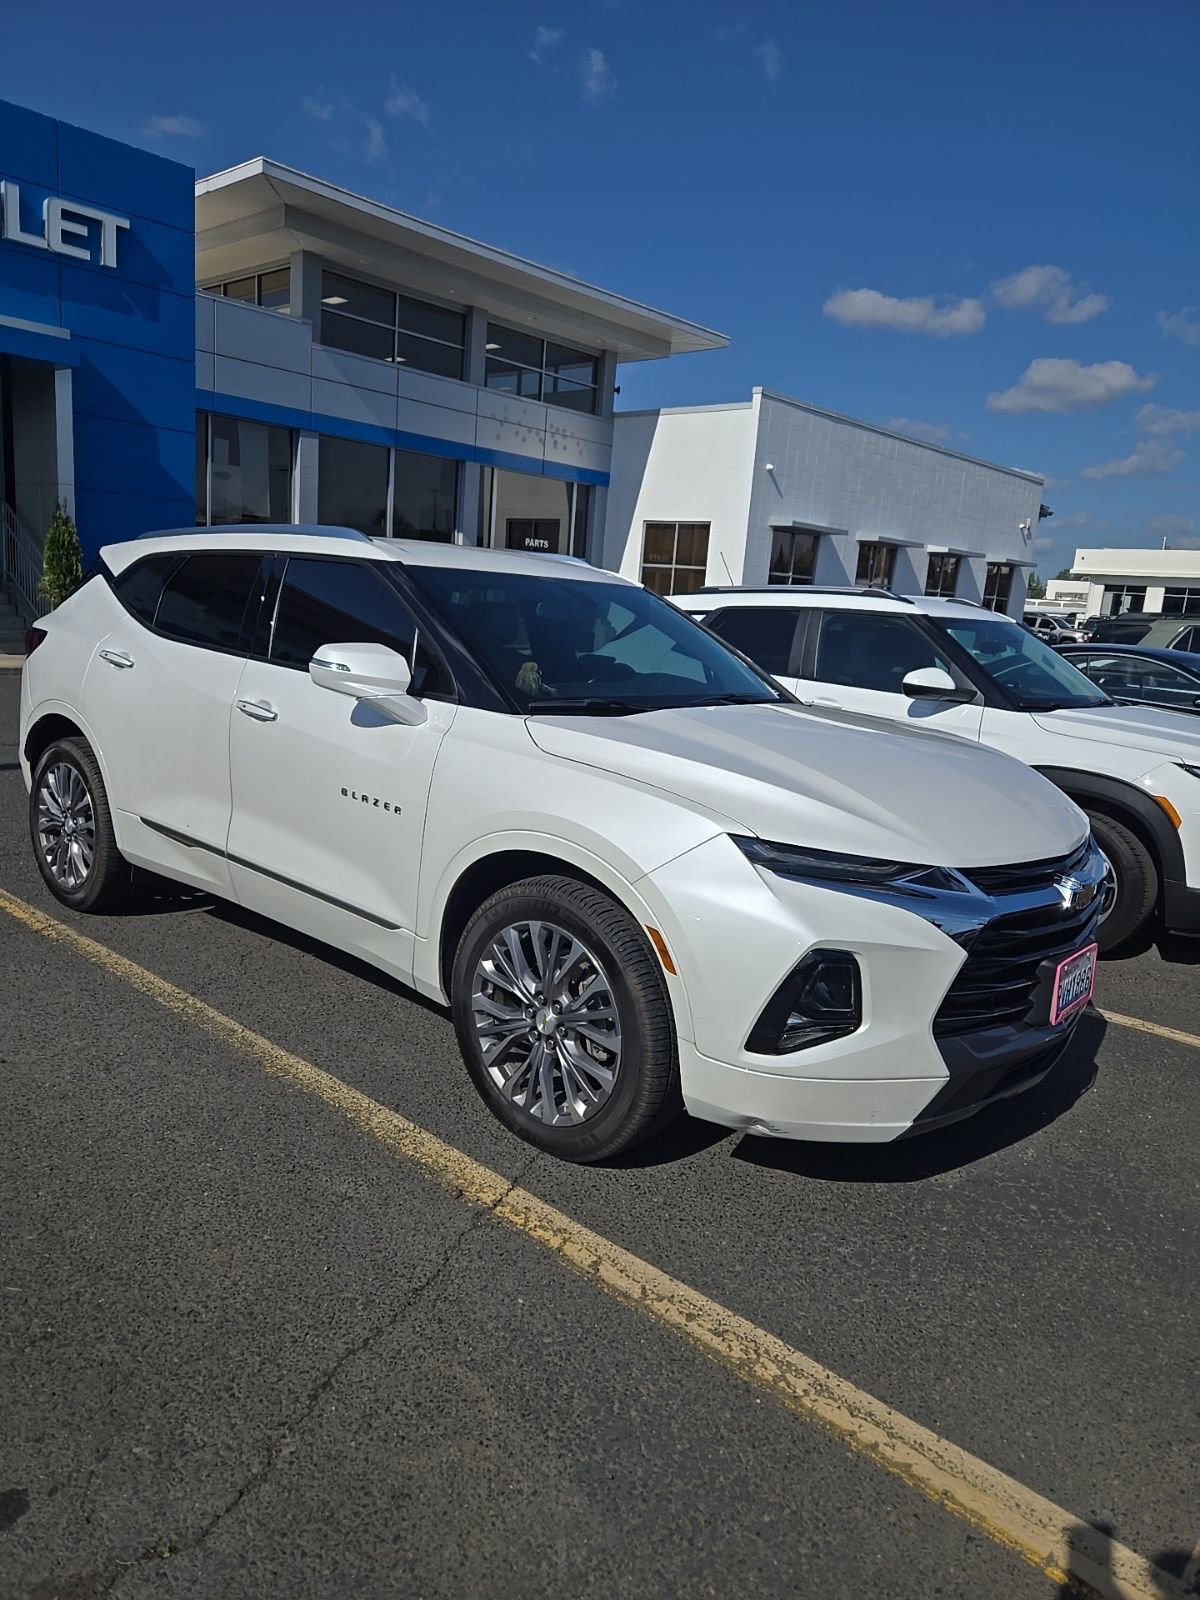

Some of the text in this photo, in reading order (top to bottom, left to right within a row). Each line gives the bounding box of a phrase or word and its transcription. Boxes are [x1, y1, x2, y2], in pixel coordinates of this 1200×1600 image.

[0, 180, 130, 268] LET
[525, 537, 549, 548] PARTS
[341, 787, 402, 815] BLAZER
